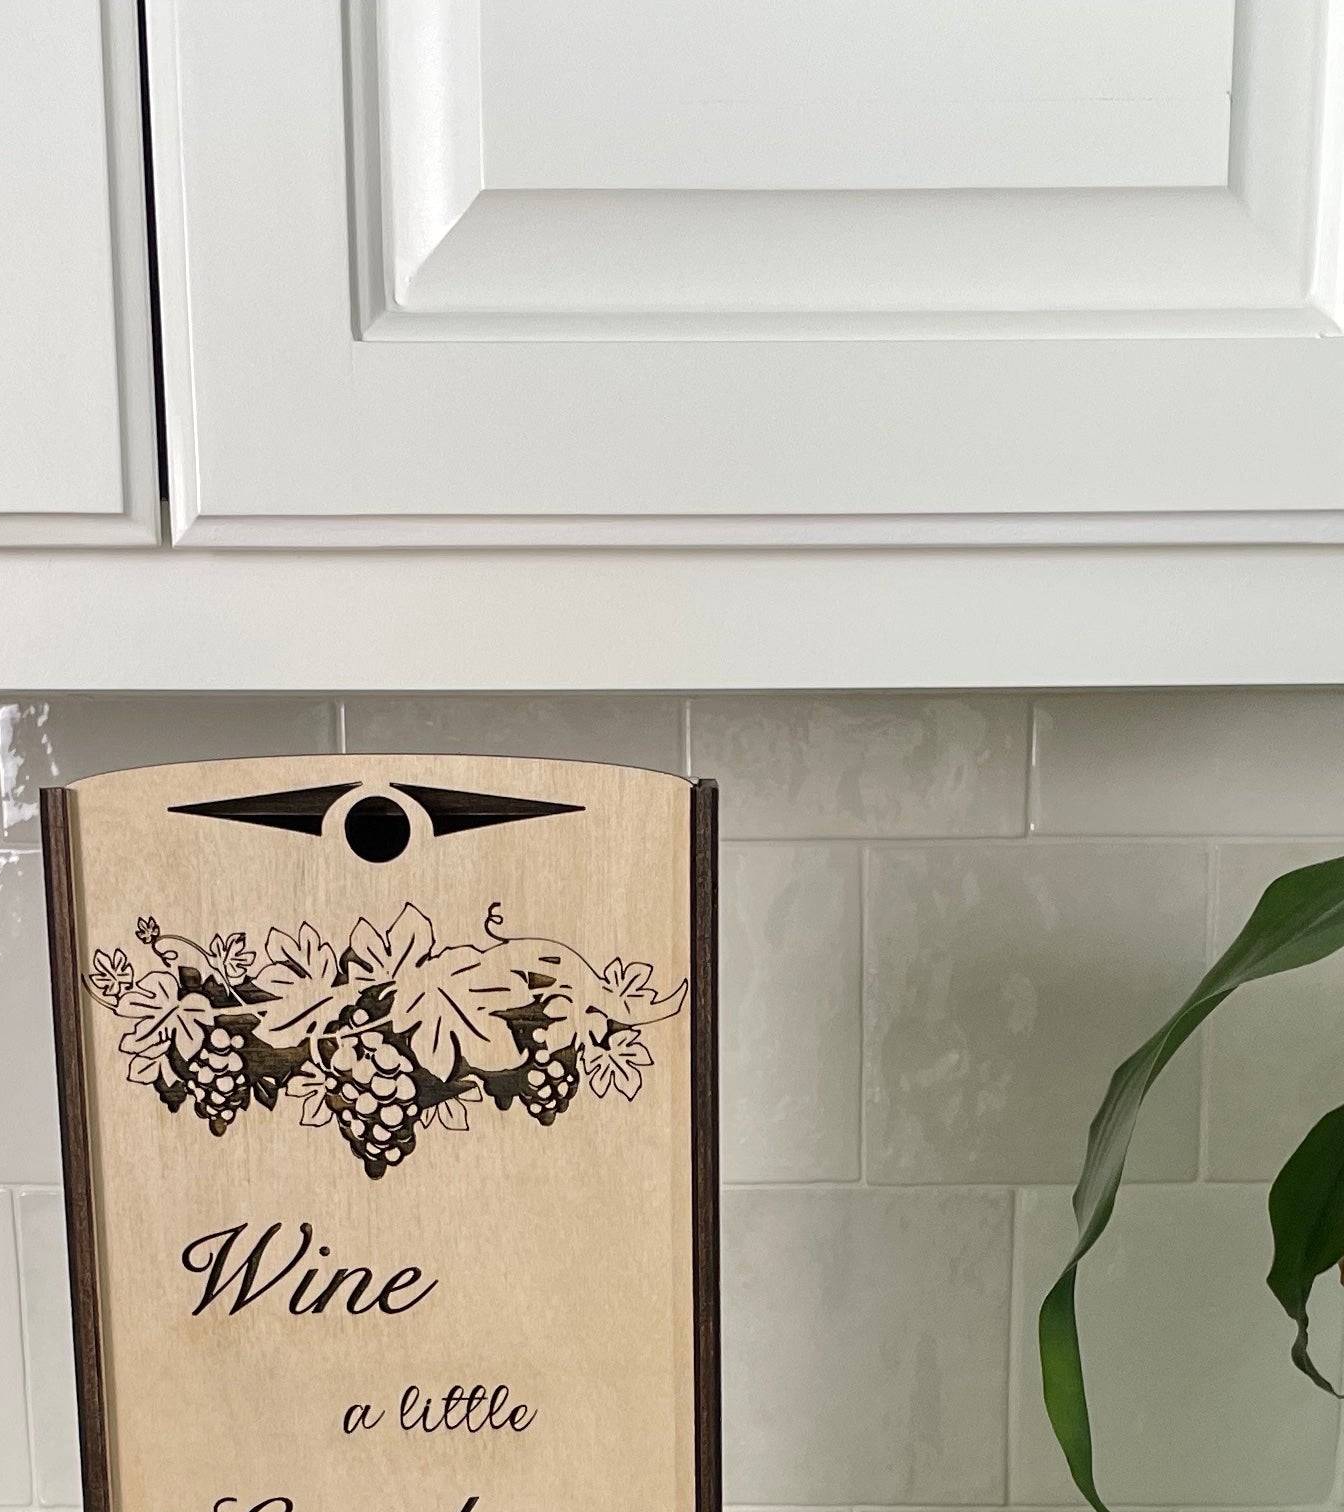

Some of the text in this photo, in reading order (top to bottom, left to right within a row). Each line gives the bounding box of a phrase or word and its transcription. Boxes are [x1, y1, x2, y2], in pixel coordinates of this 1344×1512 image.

[180, 1221, 439, 1317] Wine
[342, 1383, 539, 1435] a little
